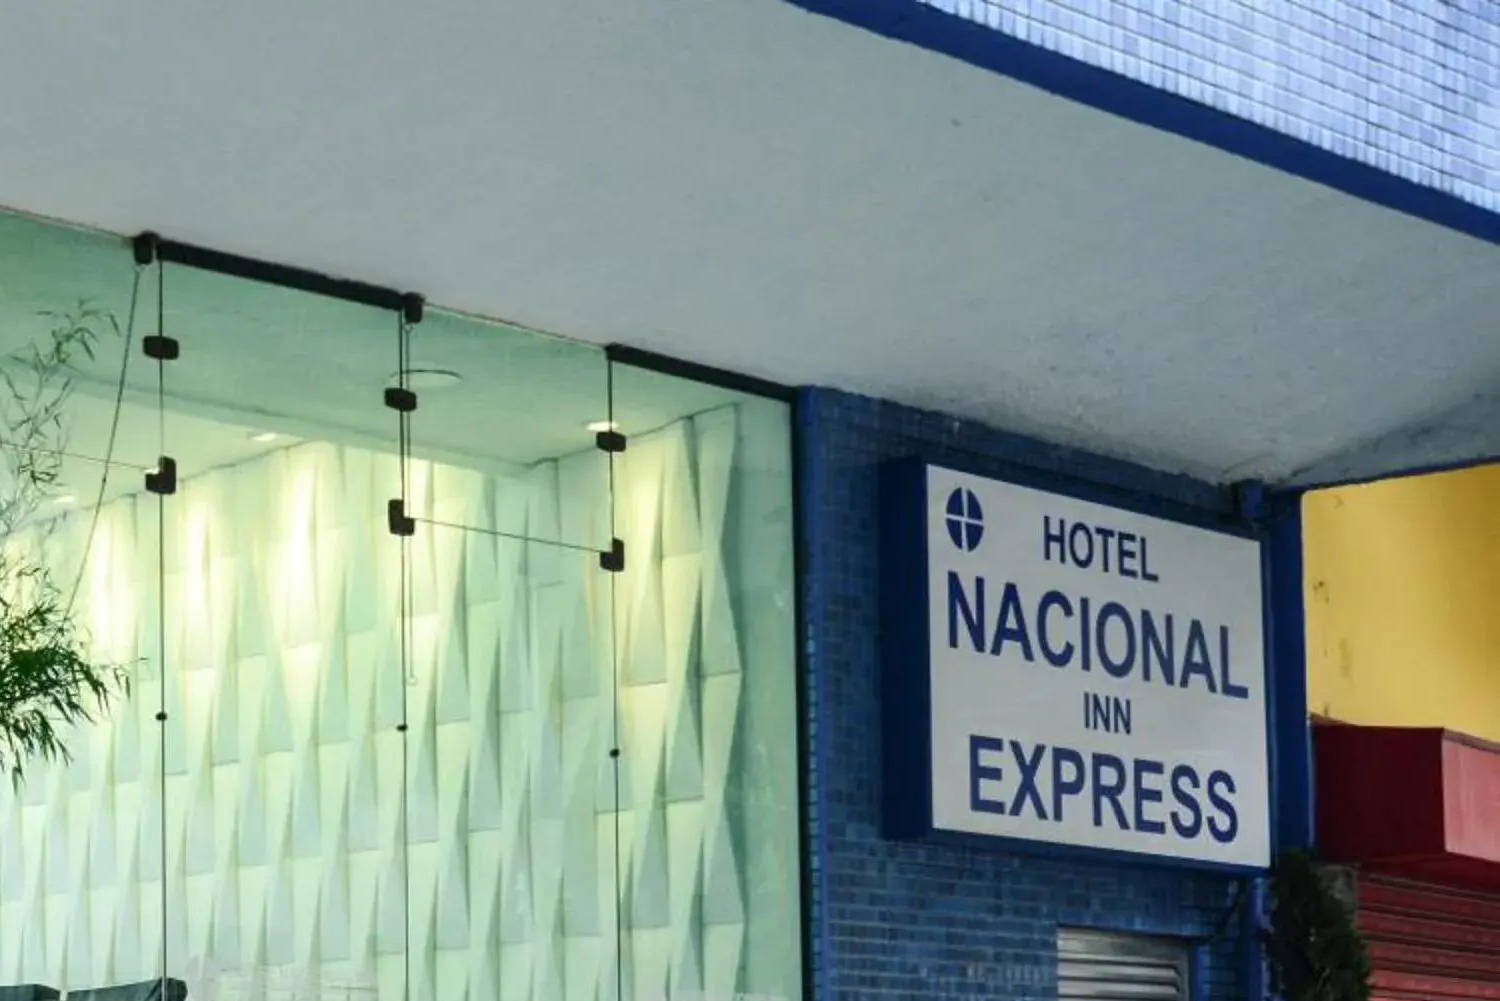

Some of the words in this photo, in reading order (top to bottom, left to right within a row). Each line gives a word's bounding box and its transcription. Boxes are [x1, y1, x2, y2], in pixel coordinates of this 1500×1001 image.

[1043, 515, 1160, 583] HOTEL
[947, 570, 1249, 699] NACIONAL
[1083, 691, 1132, 735] INN
[969, 734, 1239, 843] EXPRESS
